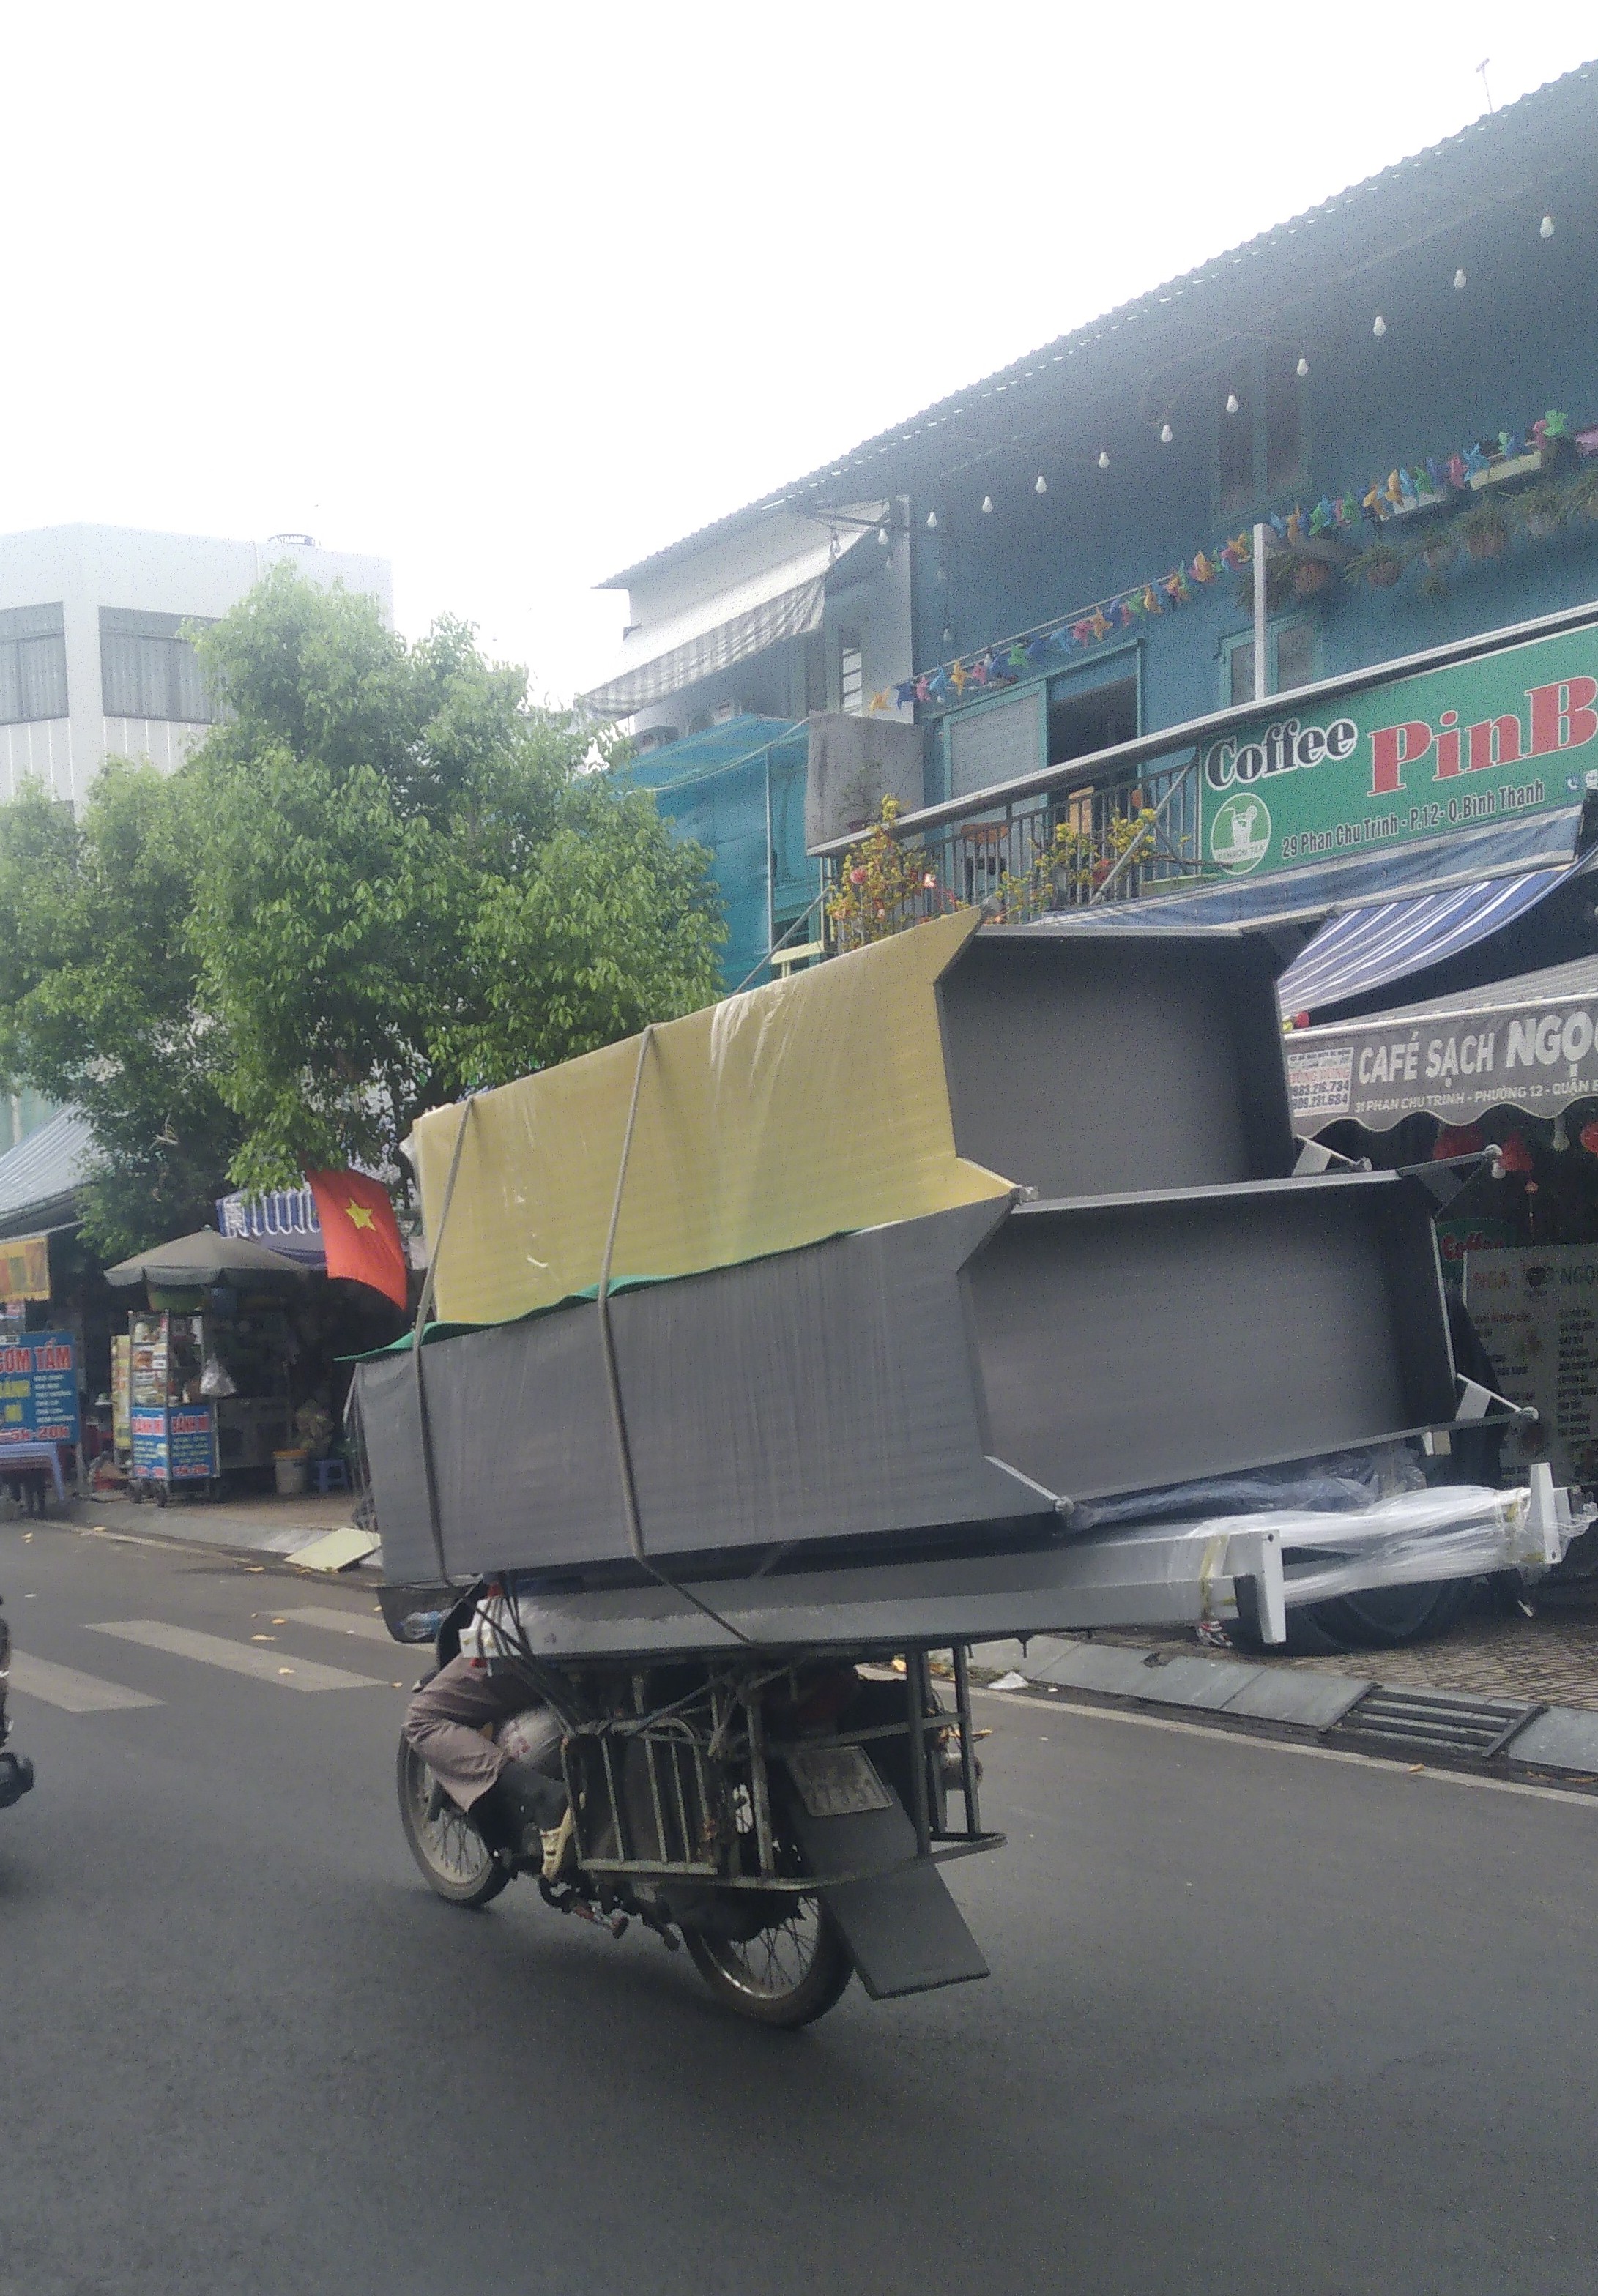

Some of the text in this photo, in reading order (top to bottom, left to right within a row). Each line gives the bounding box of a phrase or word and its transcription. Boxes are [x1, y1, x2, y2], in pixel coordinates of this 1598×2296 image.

[1205, 676, 1598, 797] Coffee PinB
[1282, 835, 1297, 859] 29
[1300, 829, 1333, 855] Phan
[1335, 824, 1360, 846] Chu
[1359, 1011, 1598, 1087] CAFÉ SẠCH NGỌ
[1367, 1098, 1398, 1111] PHAN
[1401, 1096, 1425, 1109] CHU
[1529, 1084, 1544, 1097] 12
